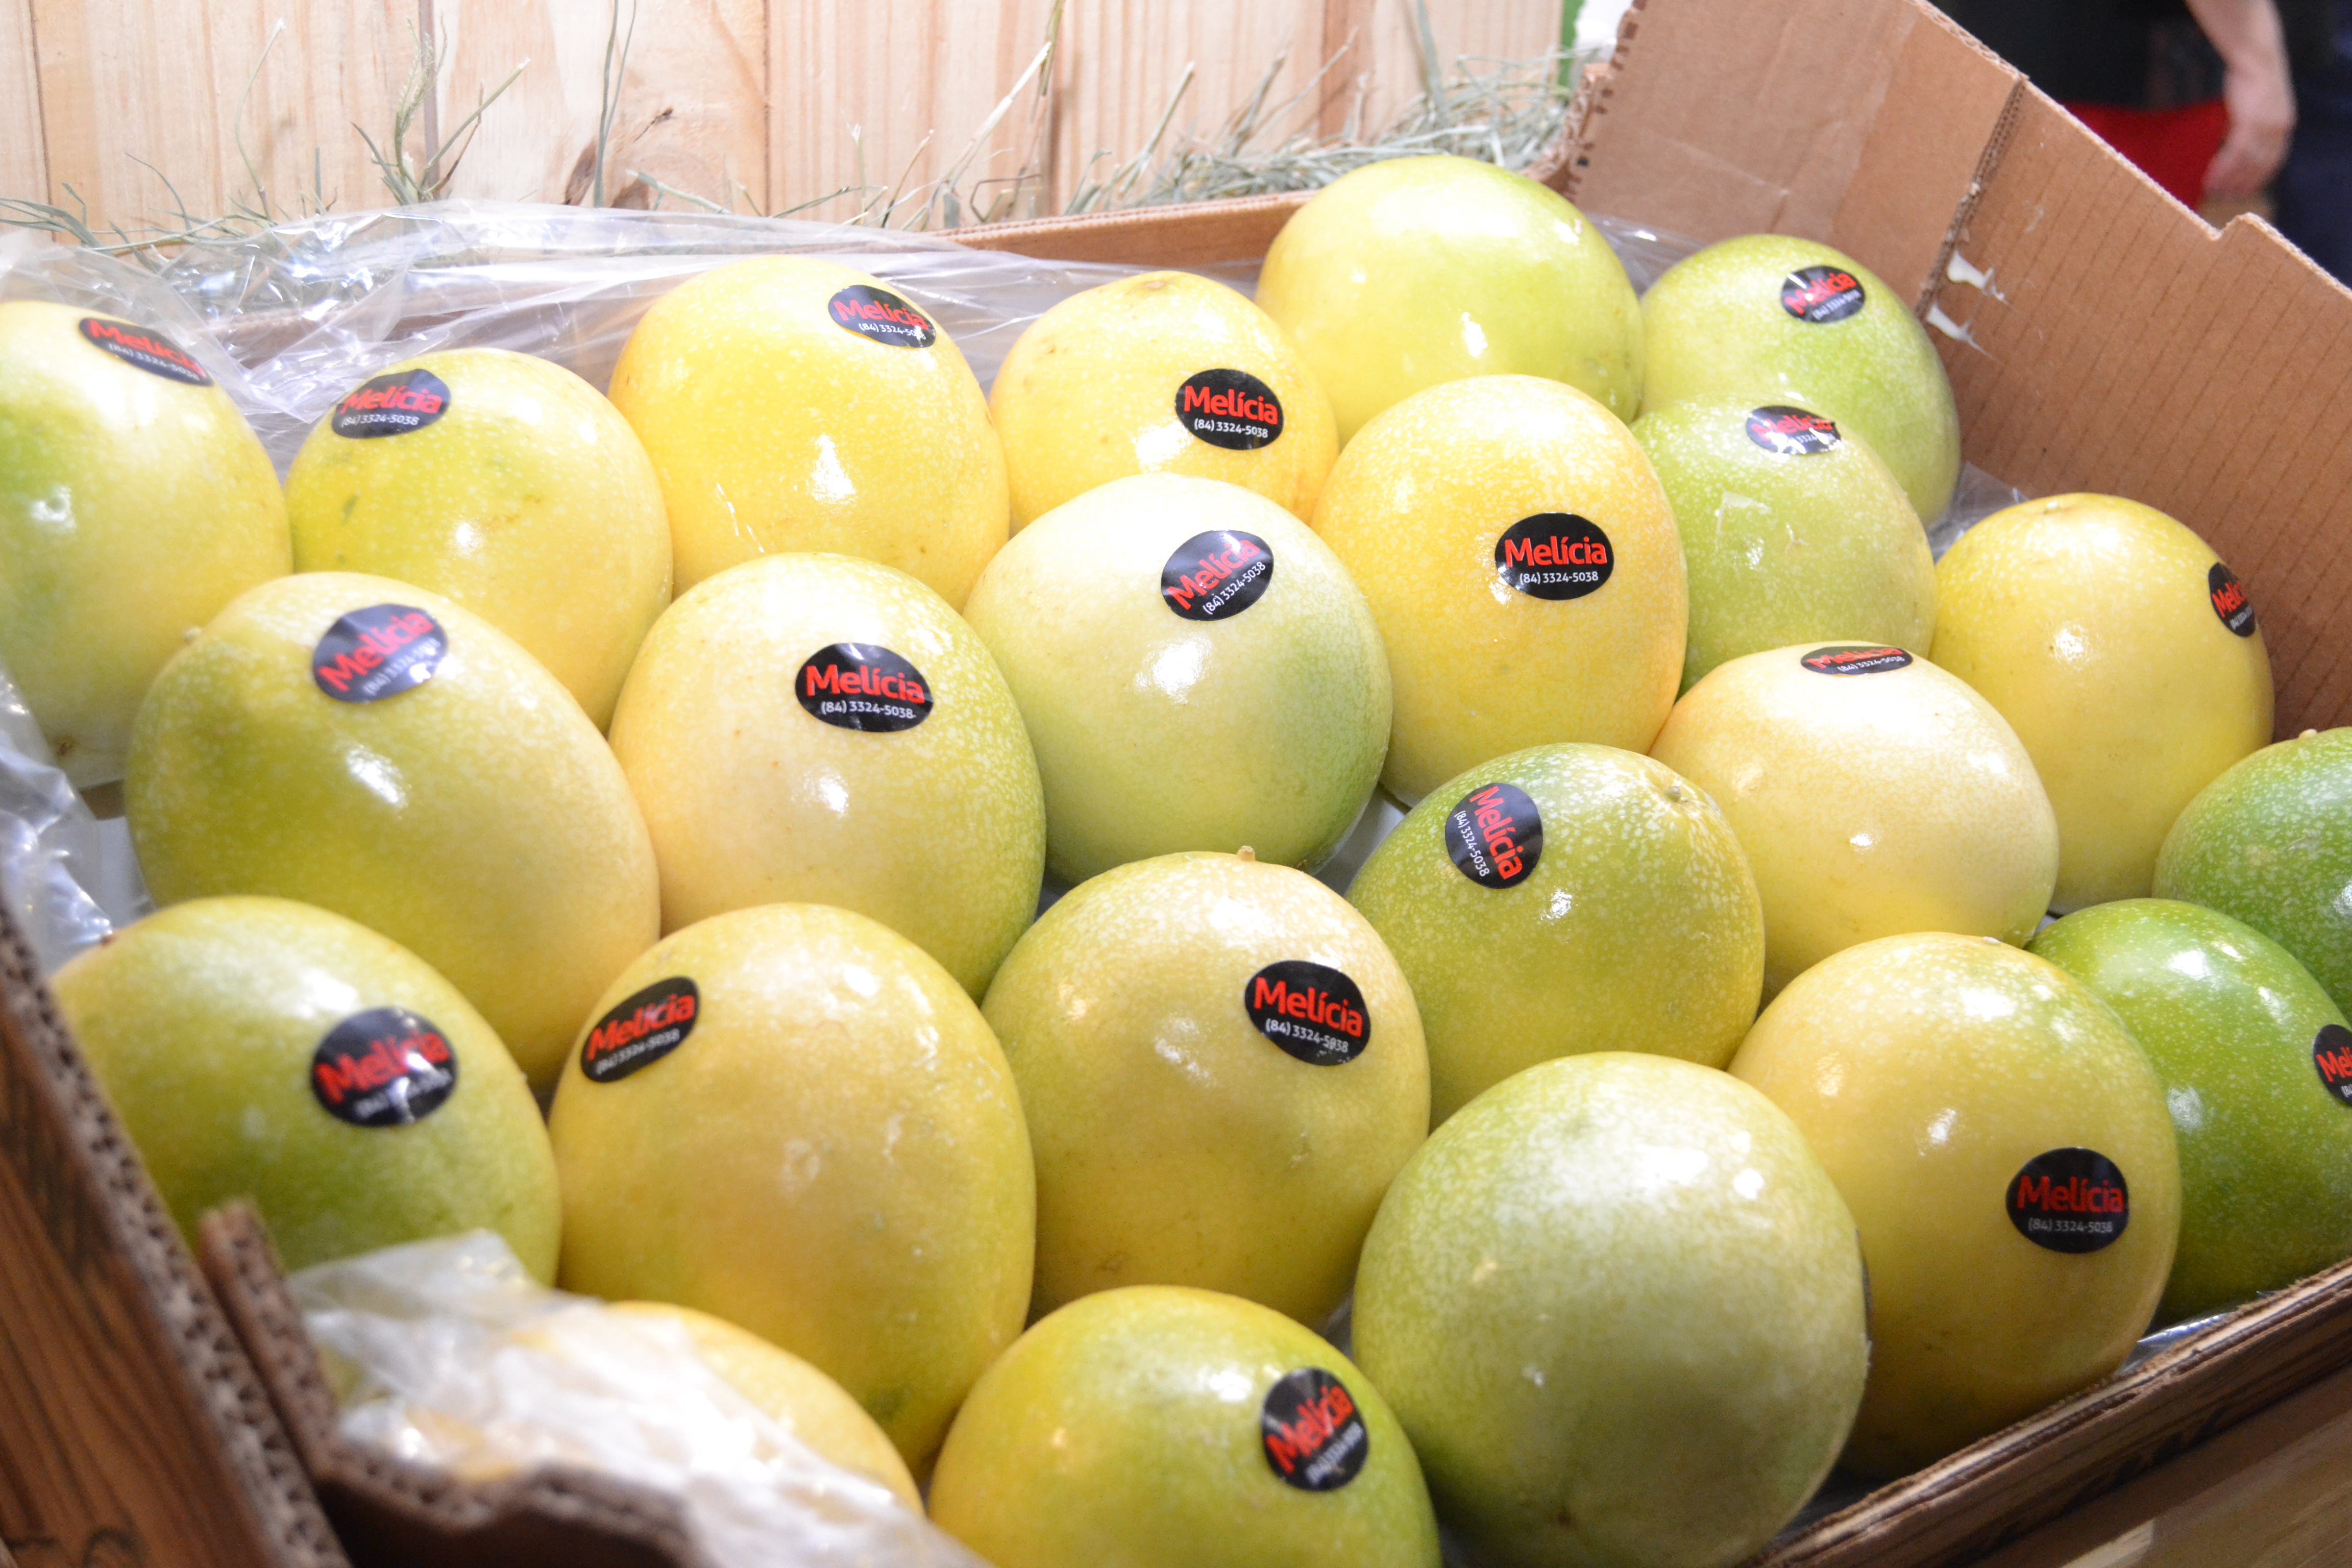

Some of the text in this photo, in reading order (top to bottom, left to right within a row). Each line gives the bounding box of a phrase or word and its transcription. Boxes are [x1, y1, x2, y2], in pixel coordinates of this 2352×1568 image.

[1784, 273, 1856, 315] Melícia
[834, 300, 928, 329] Melícia
[859, 323, 926, 339] (84) 3324-50
[341, 385, 442, 414] Melícia
[1184, 386, 1278, 425] Melícia
[341, 414, 419, 427] (84) 3324-5038
[1195, 419, 1268, 438] (84) 3324-5038
[1504, 535, 1607, 567] Melícia
[1167, 540, 1260, 610] Melícia
[1203, 561, 1266, 615] (84) 3324-5038
[1520, 571, 1598, 584] (84) 3324-5038
[318, 612, 433, 692] Melícia
[1806, 648, 1904, 668] Melícia
[1838, 656, 1905, 672] (84) 3324-5038
[806, 664, 925, 704] Melícia
[821, 700, 913, 719] (84) 3324-5038
[1454, 811, 1490, 877] (84) 3324-5038
[1469, 786, 1524, 879] Melícia
[1254, 977, 1363, 1037] Melícia
[587, 993, 695, 1061] Melícia
[1265, 1019, 1348, 1053] (84) 3324-5038
[2017, 1175, 2123, 1212] Melícia
[2029, 1218, 2113, 1233] (84) 3324-5038
